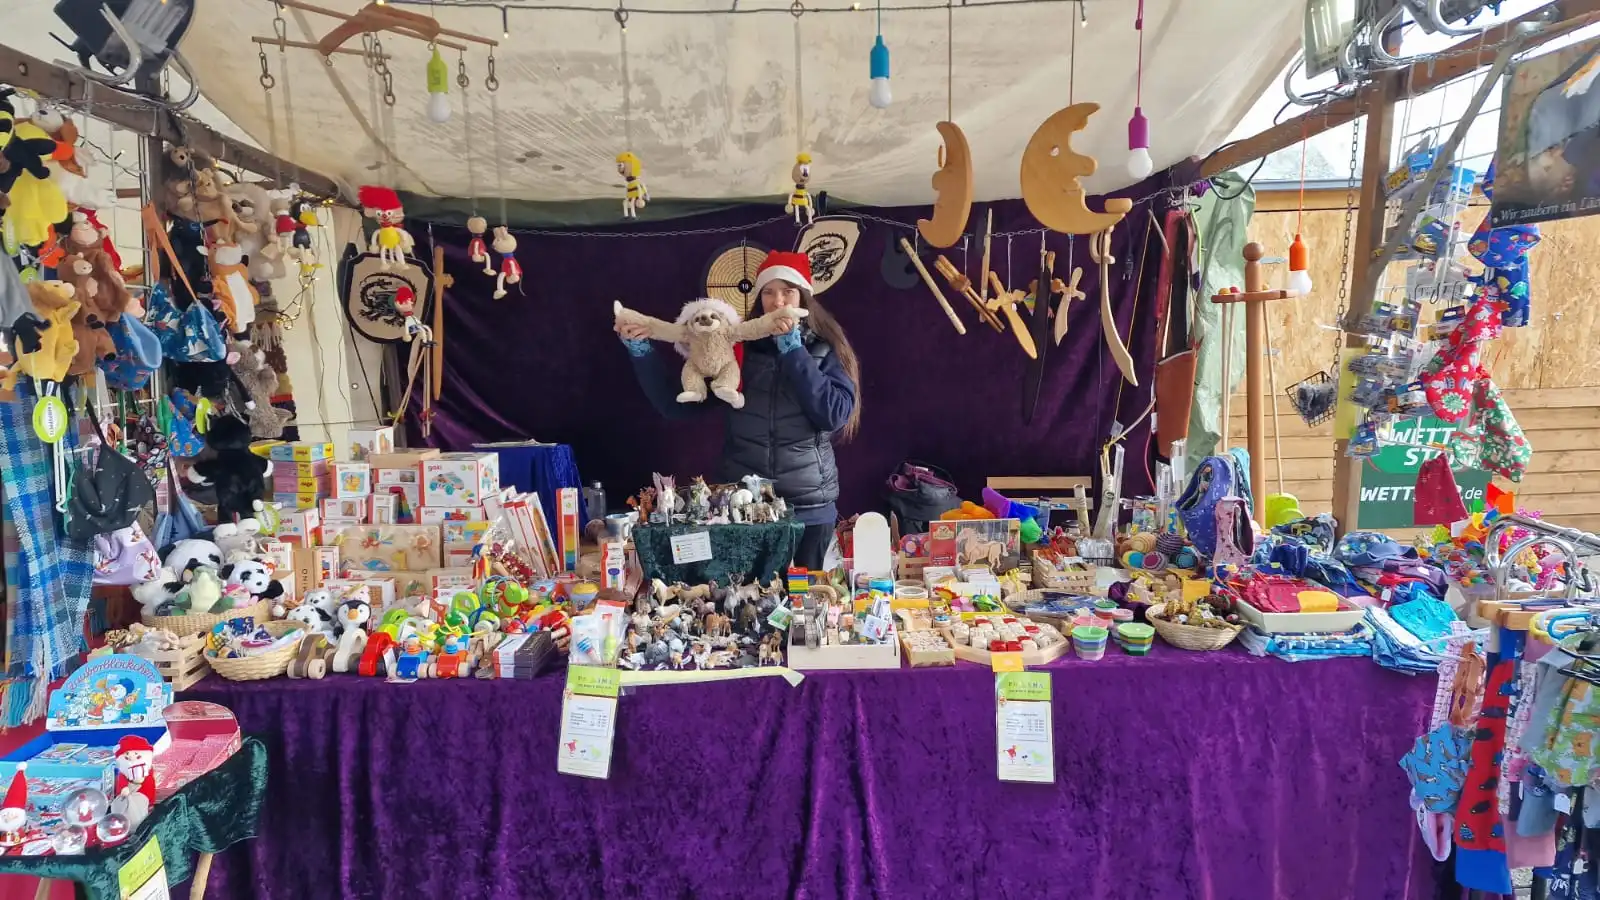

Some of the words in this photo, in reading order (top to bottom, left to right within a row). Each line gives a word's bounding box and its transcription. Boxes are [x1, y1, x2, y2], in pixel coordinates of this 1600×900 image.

[1501, 209, 1518, 220] Wir
[1520, 201, 1559, 218] zaubern
[1560, 200, 1577, 212] ein
